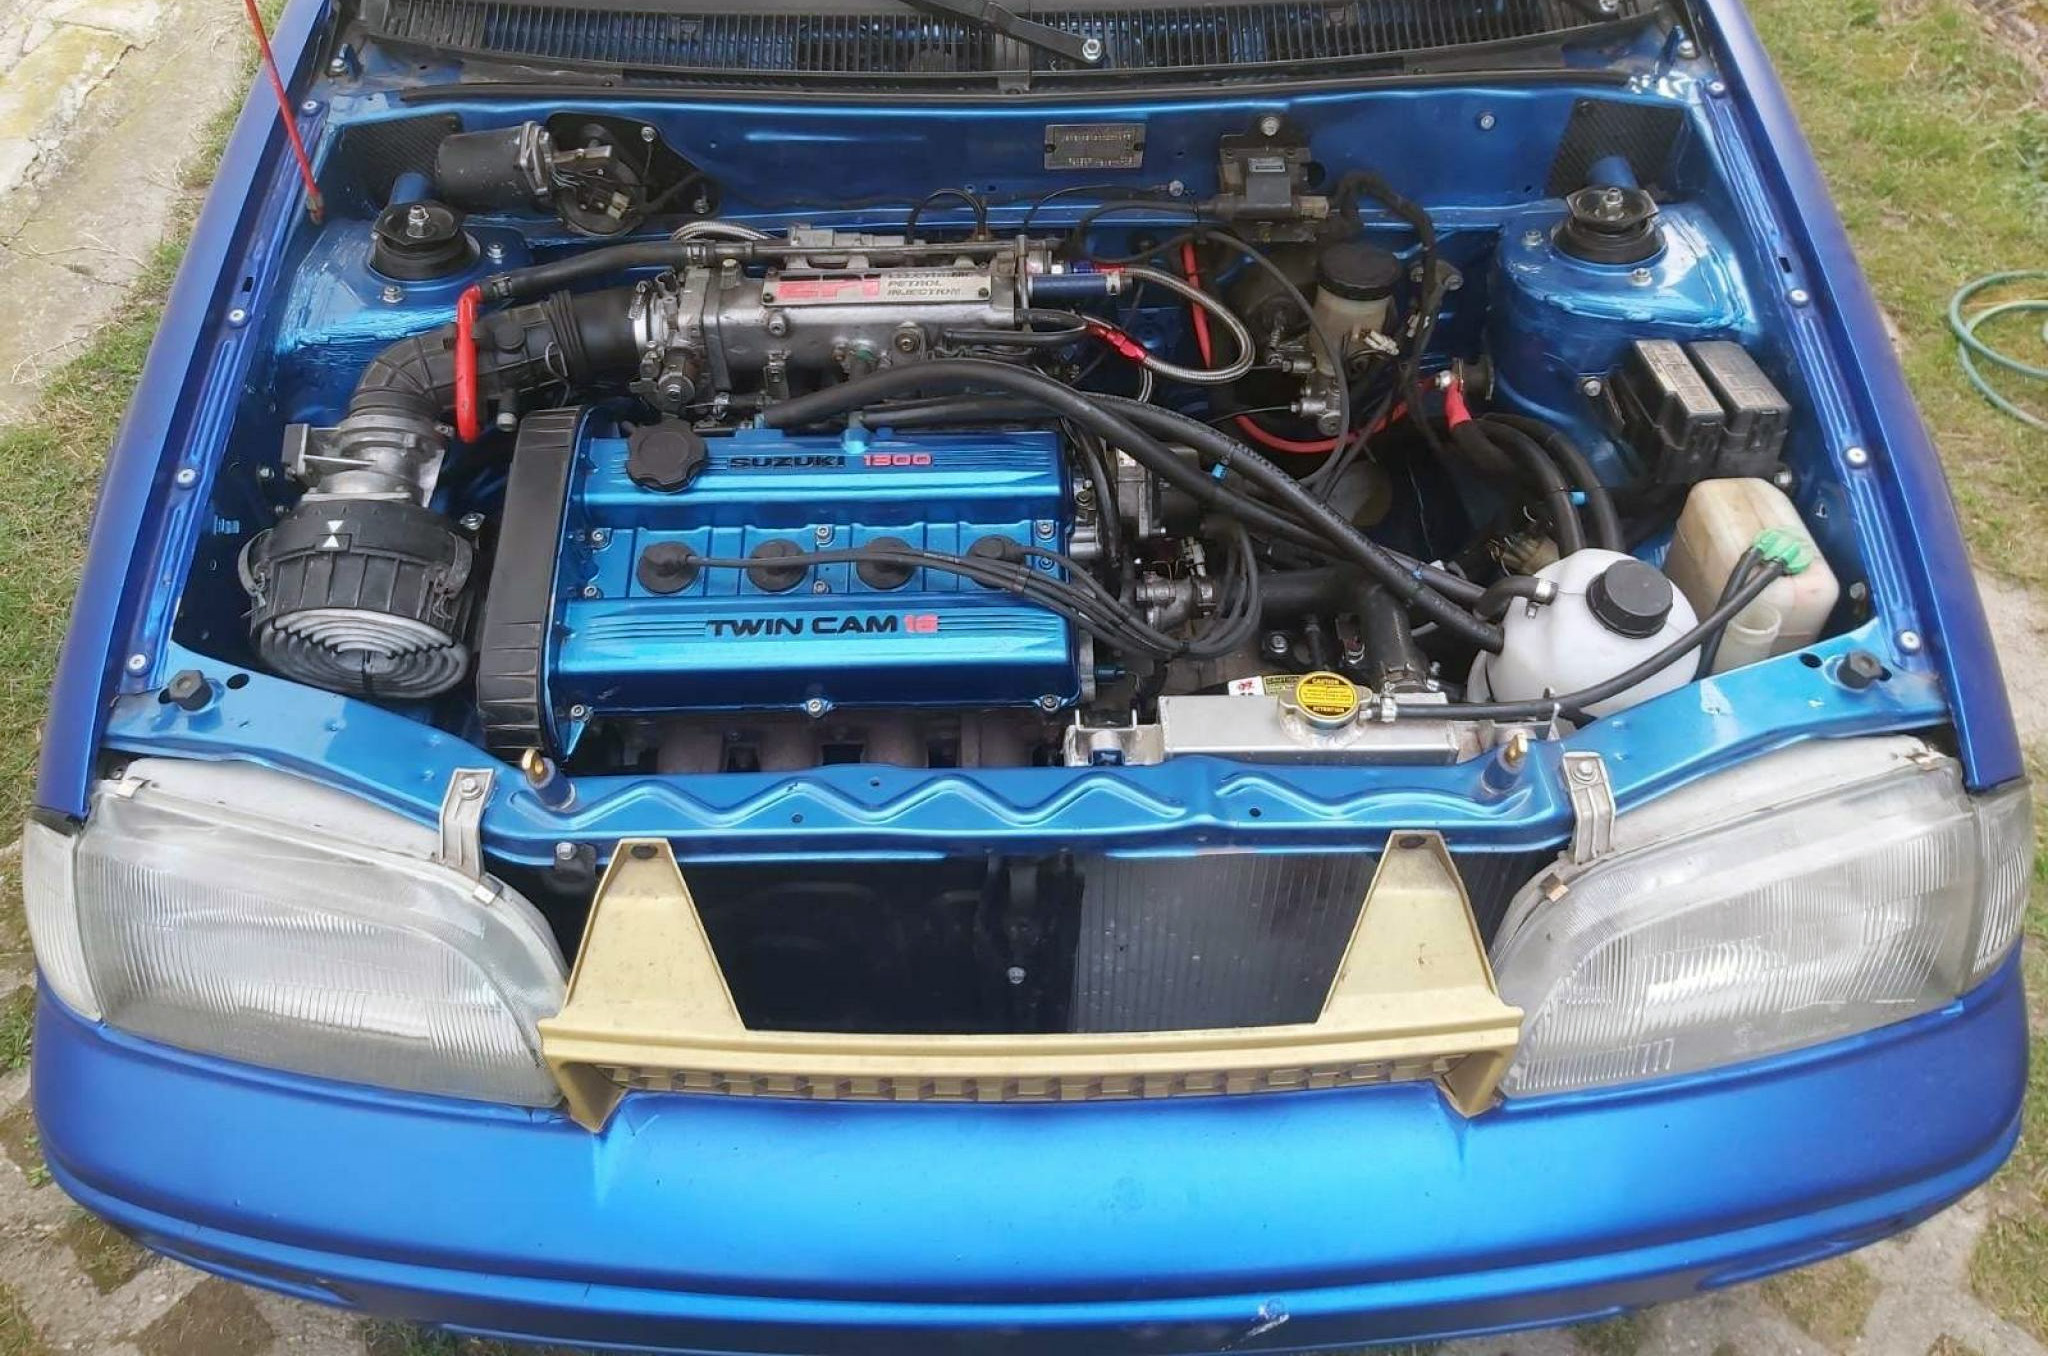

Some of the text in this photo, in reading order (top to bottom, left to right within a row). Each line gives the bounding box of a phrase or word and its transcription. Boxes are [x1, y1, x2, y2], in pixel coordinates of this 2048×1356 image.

[729, 453, 932, 469] SUZUKI 1300
[705, 614, 938, 637] TWIN CAM 16
